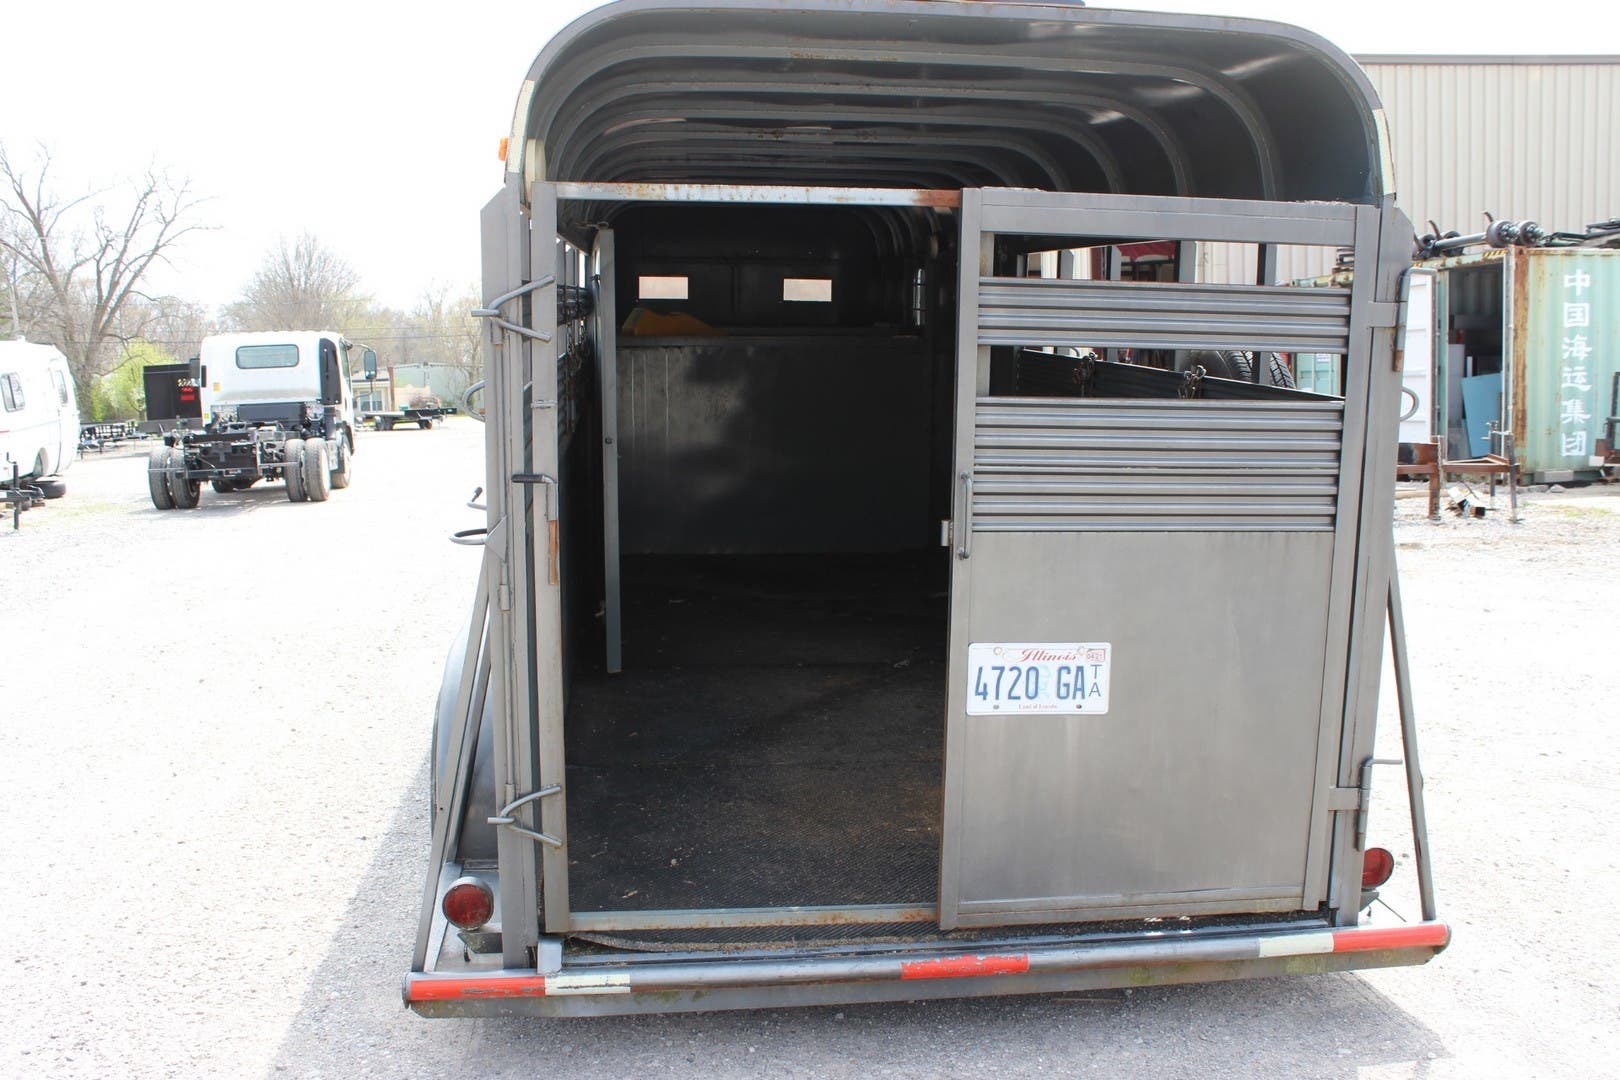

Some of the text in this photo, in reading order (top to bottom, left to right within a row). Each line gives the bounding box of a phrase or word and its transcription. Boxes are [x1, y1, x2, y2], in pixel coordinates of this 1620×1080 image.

[1561, 268, 1592, 457] 中国海运集团
[1019, 648, 1077, 663] Illinois
[975, 665, 1086, 701] 4720 GA
